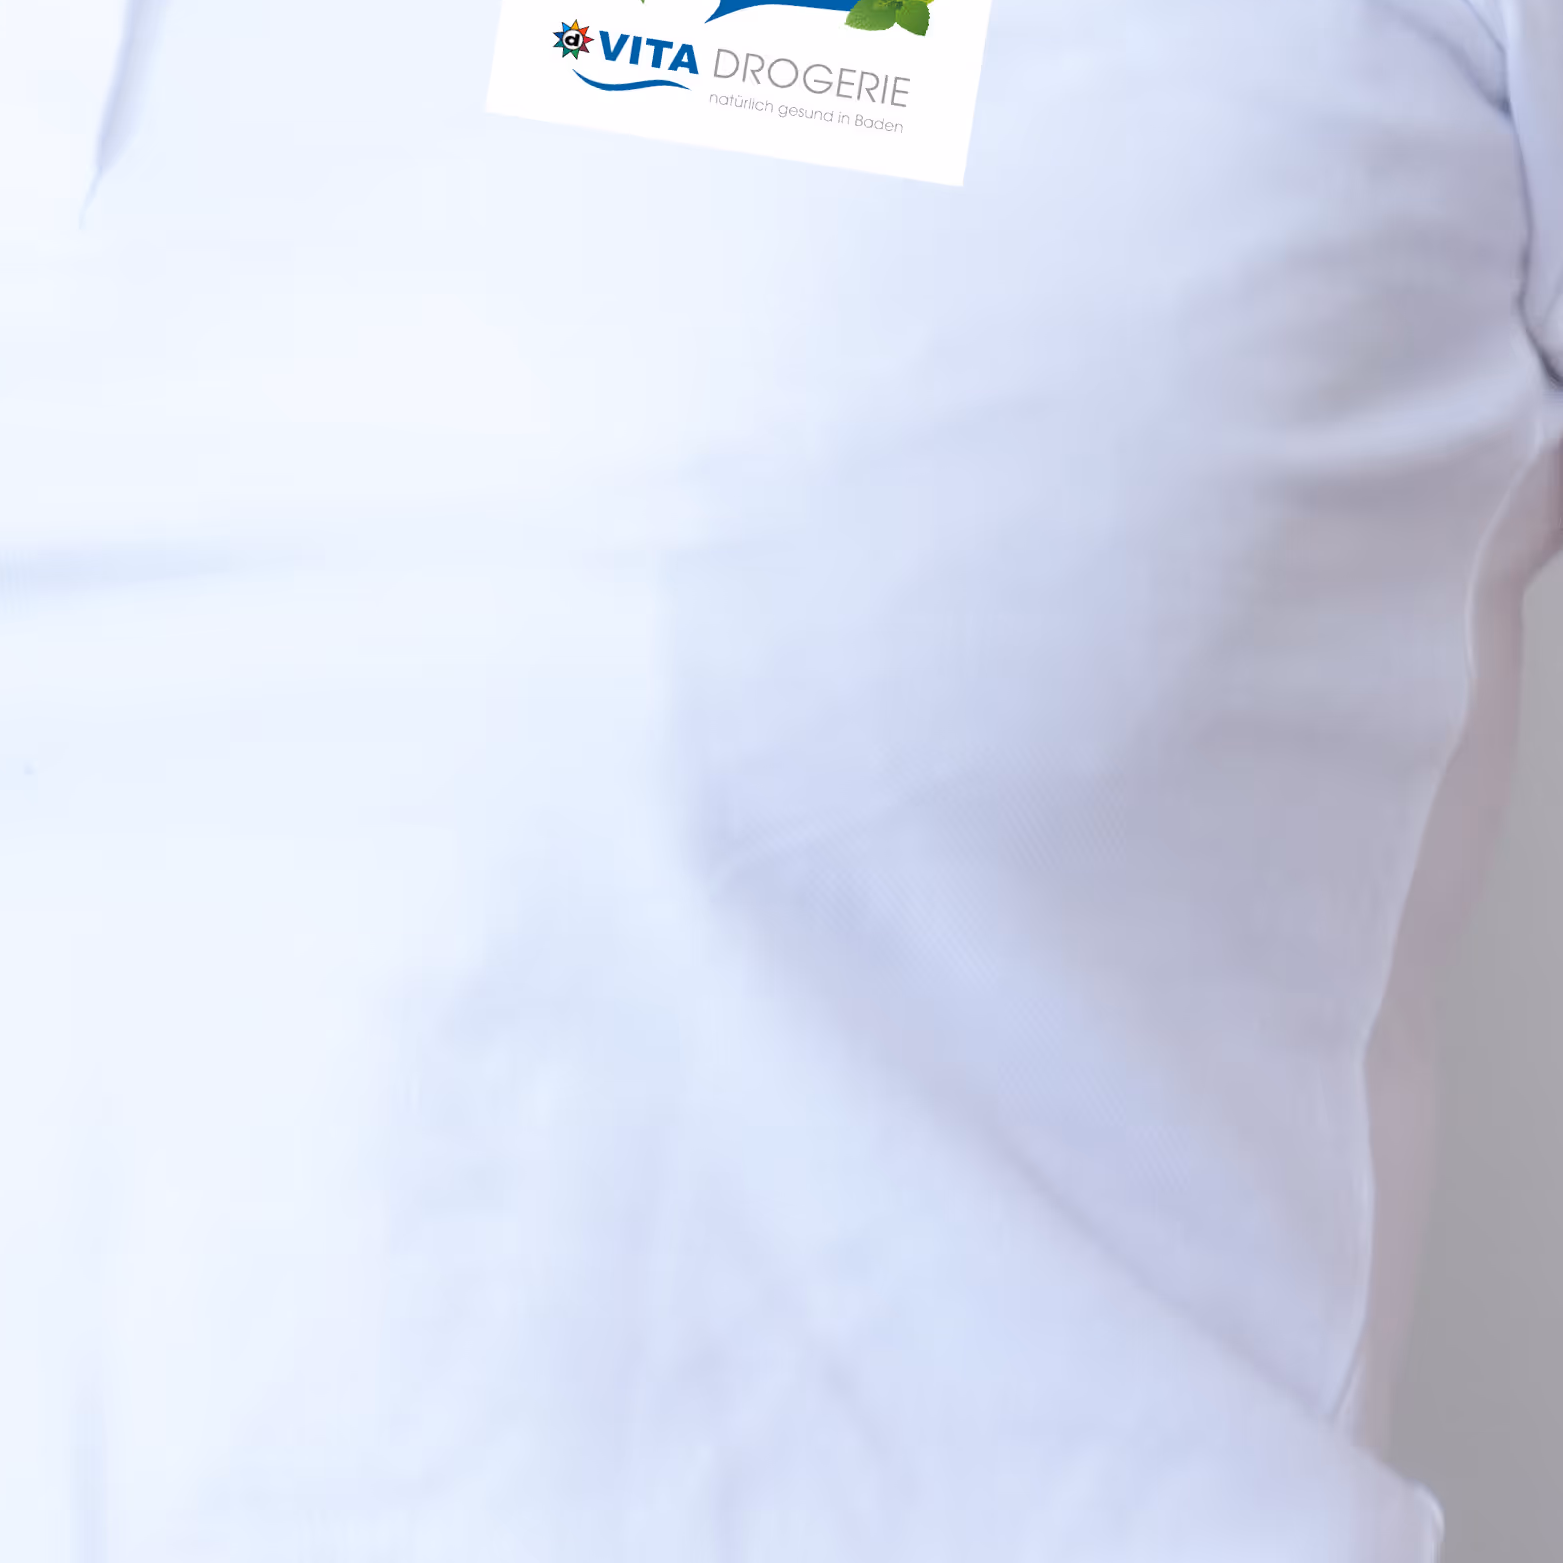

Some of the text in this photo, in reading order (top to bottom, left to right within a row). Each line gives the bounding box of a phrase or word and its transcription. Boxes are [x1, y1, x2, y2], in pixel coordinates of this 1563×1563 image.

[599, 30, 910, 108] VITA DROGERIE
[710, 94, 903, 133] natürlich gesund in Baden
